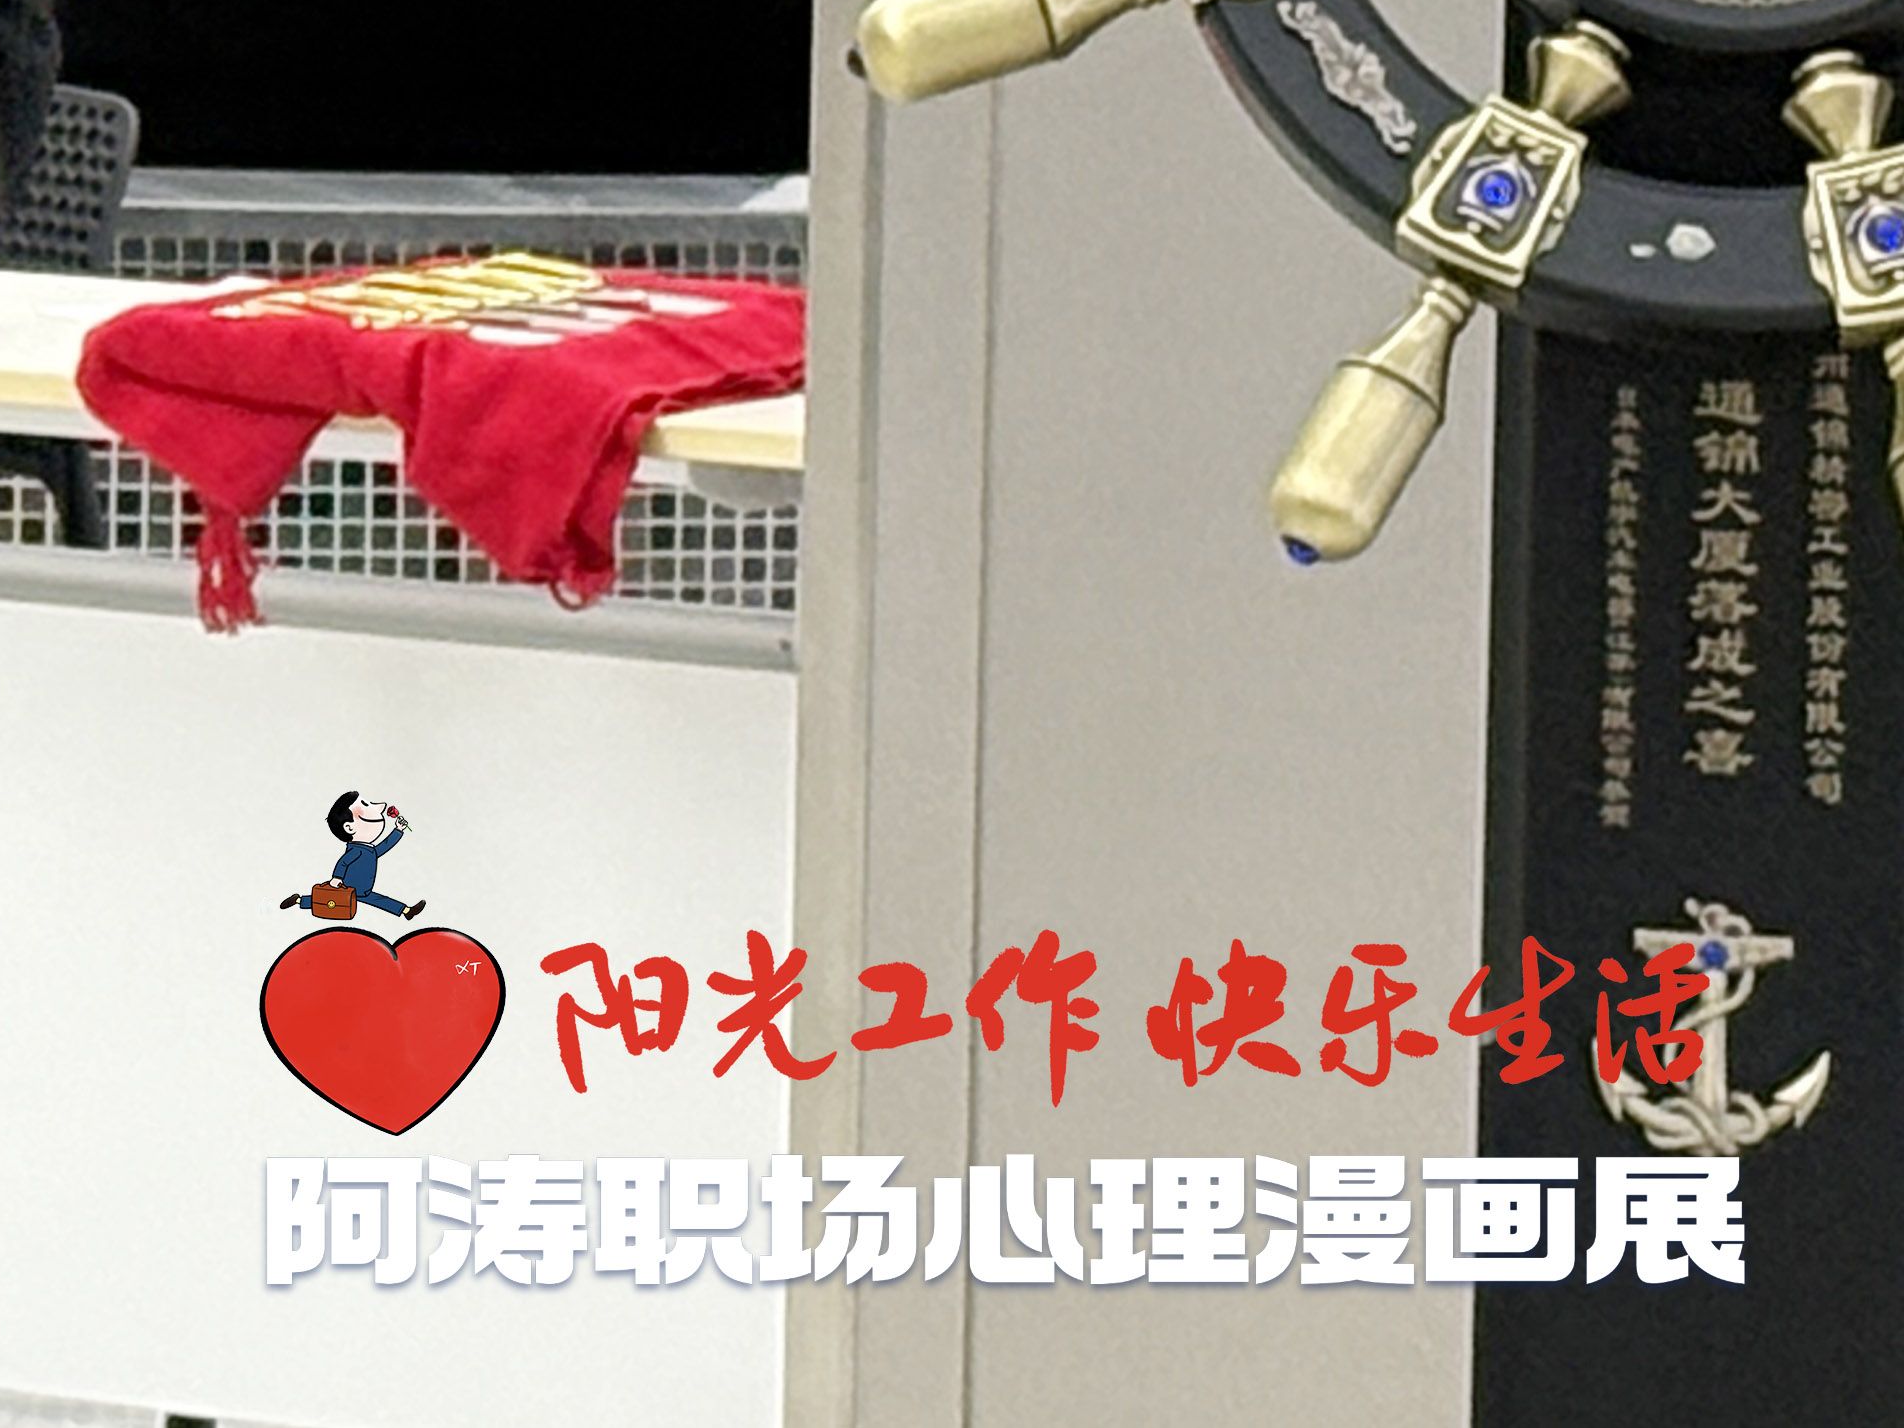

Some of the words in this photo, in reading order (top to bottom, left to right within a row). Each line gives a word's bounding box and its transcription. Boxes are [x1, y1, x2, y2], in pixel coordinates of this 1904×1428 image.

[1683, 380, 1762, 775] 通锦大厦落成之喜
